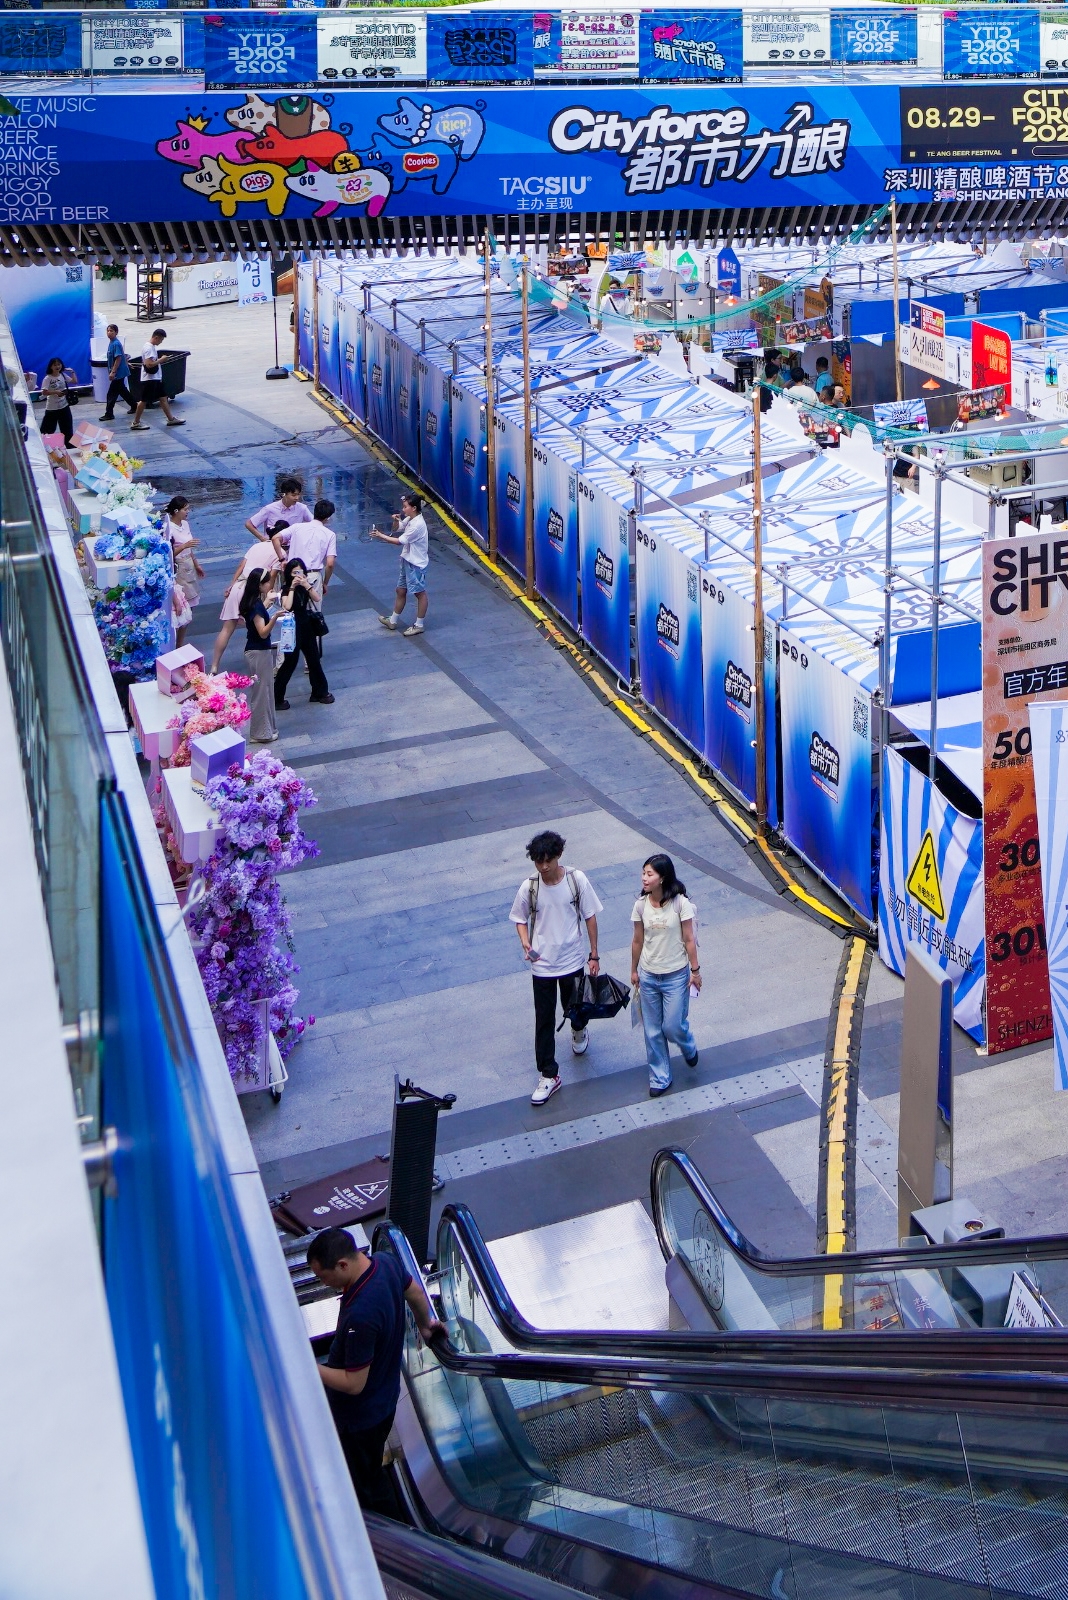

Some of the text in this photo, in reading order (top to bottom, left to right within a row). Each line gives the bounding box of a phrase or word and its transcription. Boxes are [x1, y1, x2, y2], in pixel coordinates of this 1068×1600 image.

[854, 19, 892, 31] CITY
[847, 30, 900, 43] FORCE
[853, 41, 895, 53] 2025
[7, 97, 97, 113] VE MUSIC
[907, 106, 996, 129] 08.29-
[442, 119, 468, 133] RICH
[551, 106, 746, 153] Cityforce
[406, 156, 437, 167] Cookies
[624, 120, 849, 193] 都市力酿
[956, 188, 1028, 202] SHENZHEN
[1029, 188, 1045, 200] TE
[516, 197, 574, 211] 主办呈现
[0, 206, 110, 222] CRAFT BEER
[813, 736, 839, 762] Cityforce
